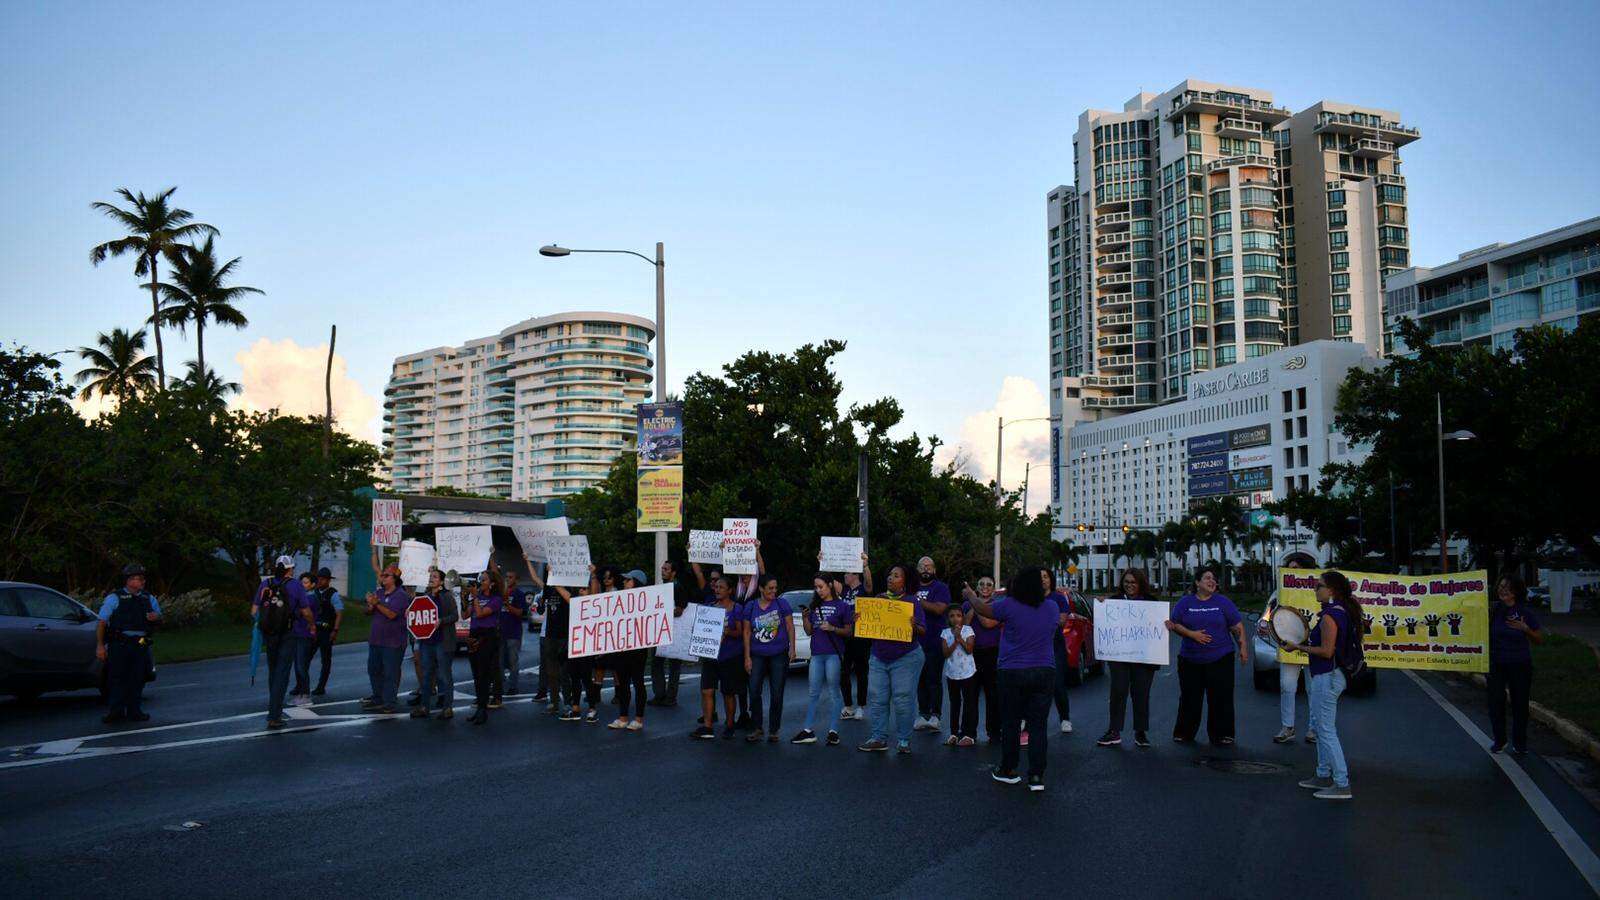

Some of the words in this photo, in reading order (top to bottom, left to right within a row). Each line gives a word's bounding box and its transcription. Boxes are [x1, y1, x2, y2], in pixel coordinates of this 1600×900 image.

[385, 501, 401, 521] UNA
[372, 524, 400, 545] MENOS
[1360, 579, 1407, 596] Amplio
[1409, 582, 1427, 594] de
[1430, 580, 1484, 596] Mujeres
[580, 591, 647, 620] ESTADO
[654, 595, 664, 609] de
[887, 601, 903, 614] ES
[1356, 596, 1389, 605] uerto
[1392, 597, 1420, 606] Rico
[408, 608, 436, 626] PARE
[571, 612, 672, 655] EMERGENCIA
[1392, 643, 1430, 652] equidad
[1431, 644, 1445, 652] de
